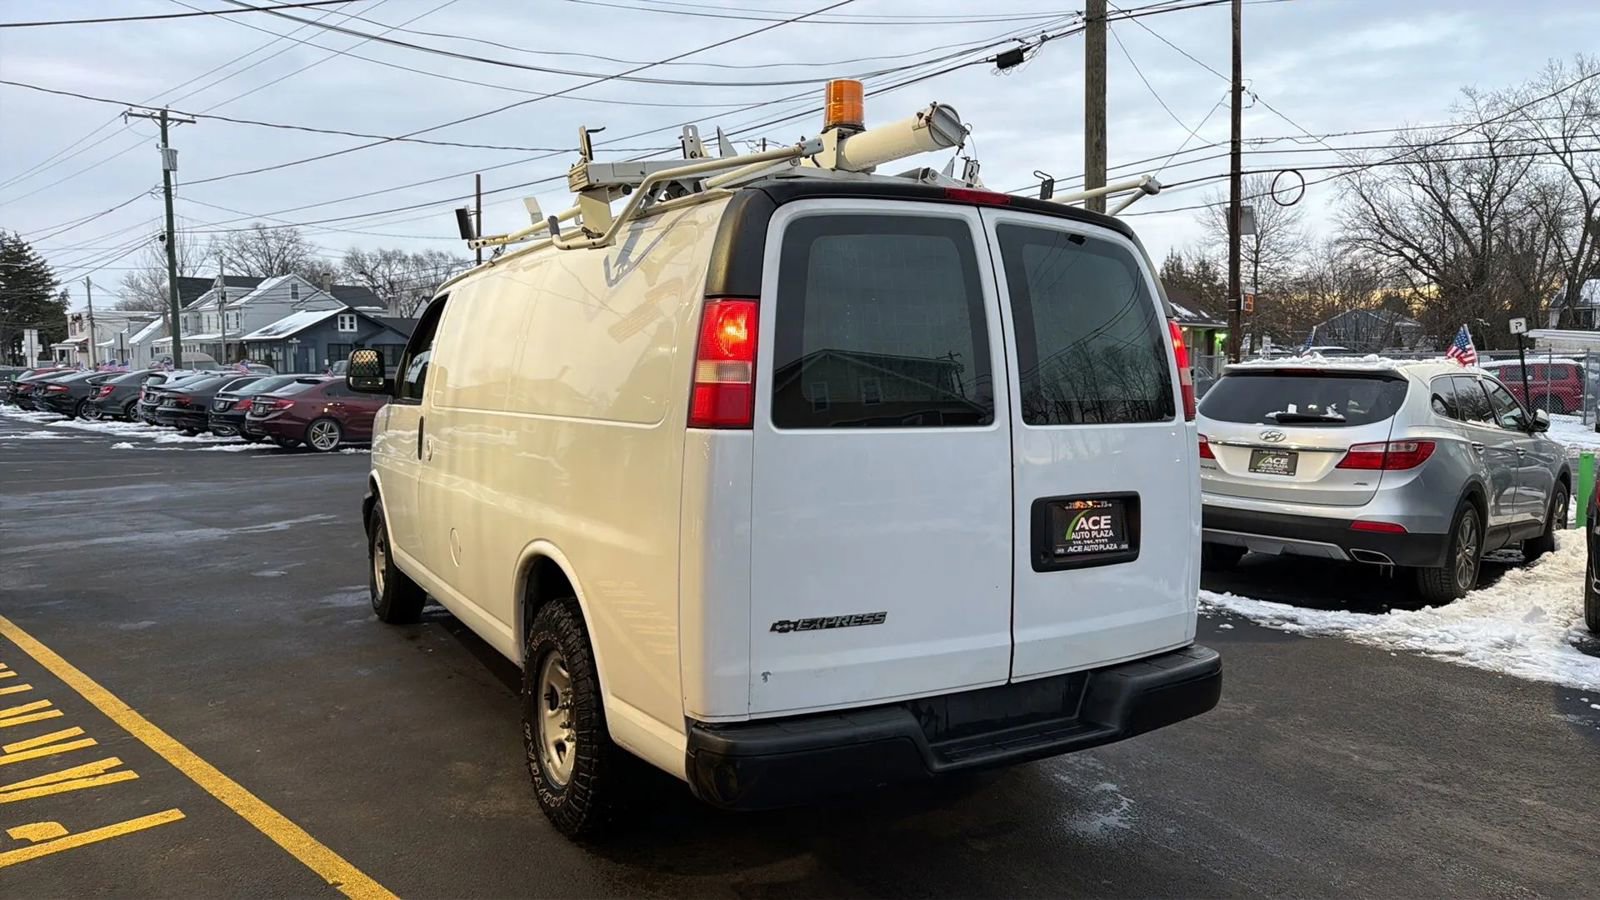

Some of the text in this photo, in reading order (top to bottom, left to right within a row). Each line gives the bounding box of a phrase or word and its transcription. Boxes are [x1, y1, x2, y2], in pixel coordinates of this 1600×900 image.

[1075, 515, 1112, 531] ACE
[1071, 529, 1114, 539] AUTO PLAZA
[1067, 545, 1083, 553] ACE
[1083, 544, 1098, 552] AUTO
[1099, 543, 1118, 551] PLAZA
[795, 611, 887, 631] EXPRESS
